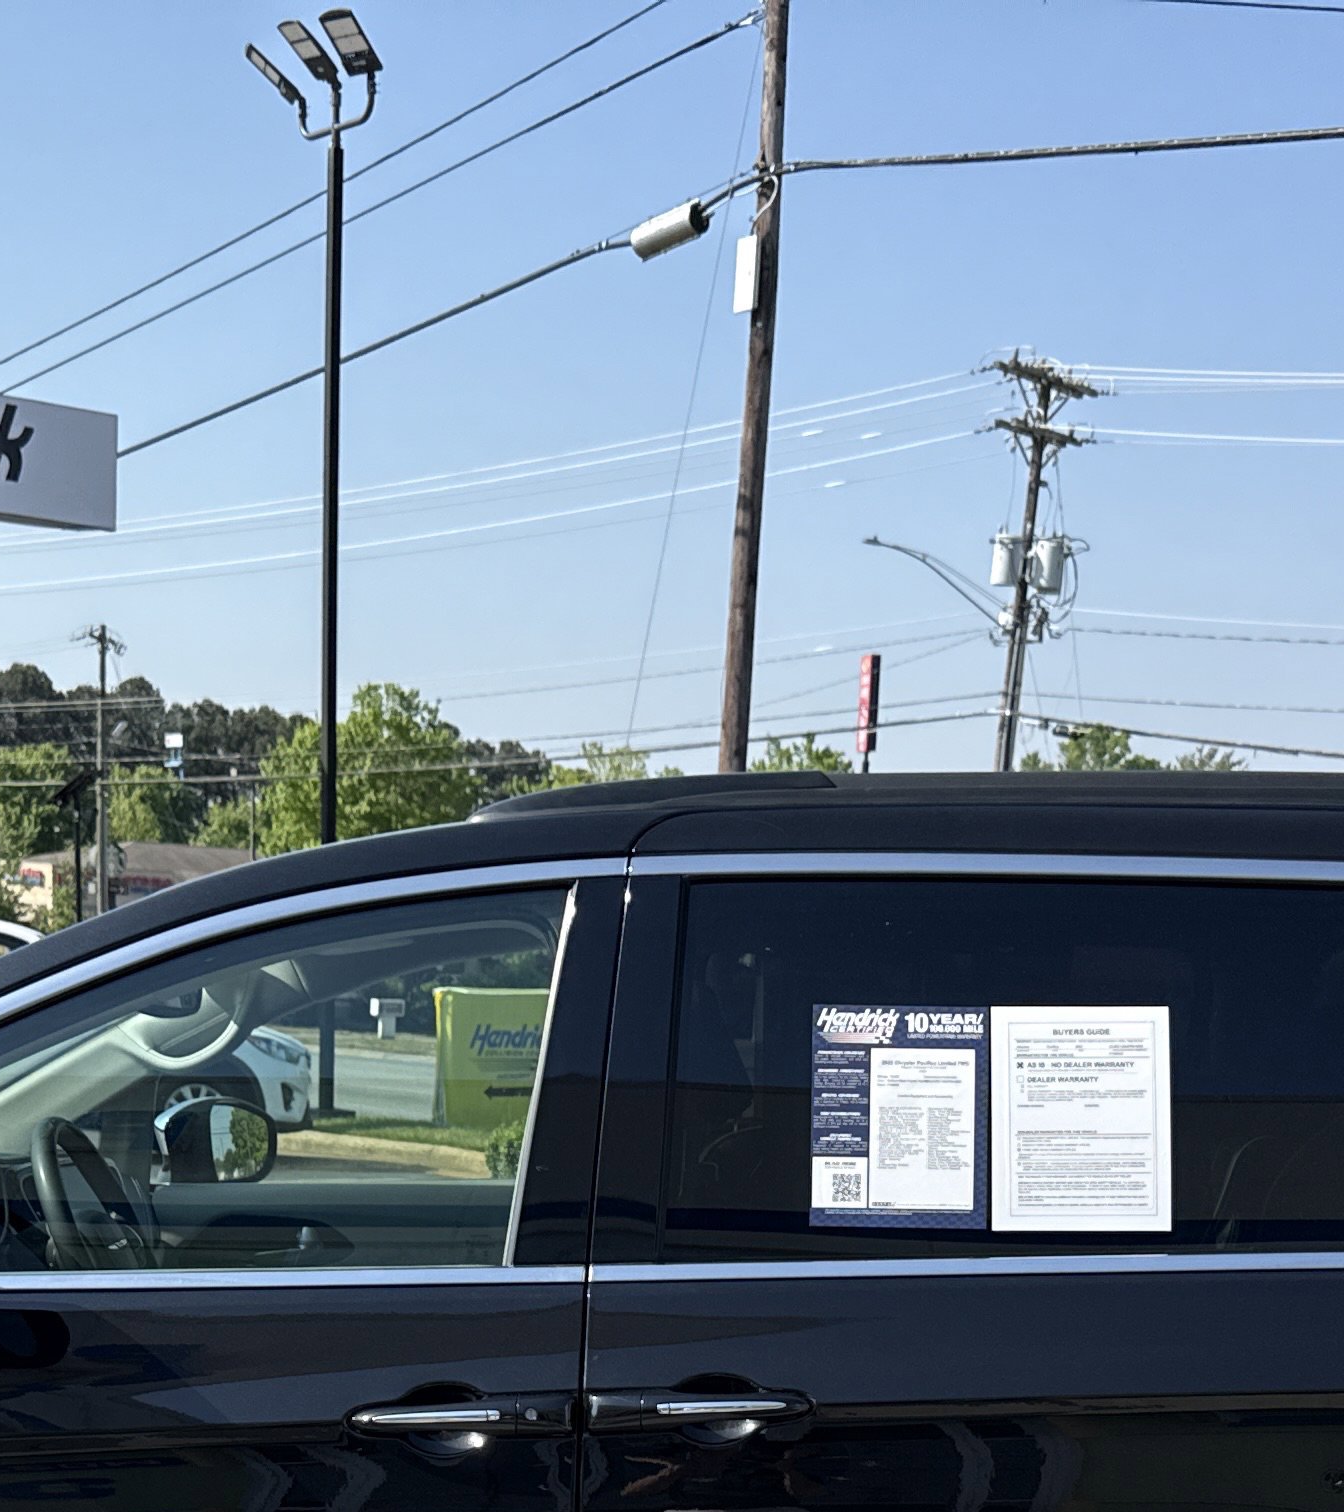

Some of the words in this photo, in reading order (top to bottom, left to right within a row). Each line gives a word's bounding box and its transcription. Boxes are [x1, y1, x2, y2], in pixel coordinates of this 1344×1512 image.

[816, 1007, 901, 1033] Hendrick
[904, 1012, 929, 1033] 10
[470, 1023, 542, 1056] Hendri
